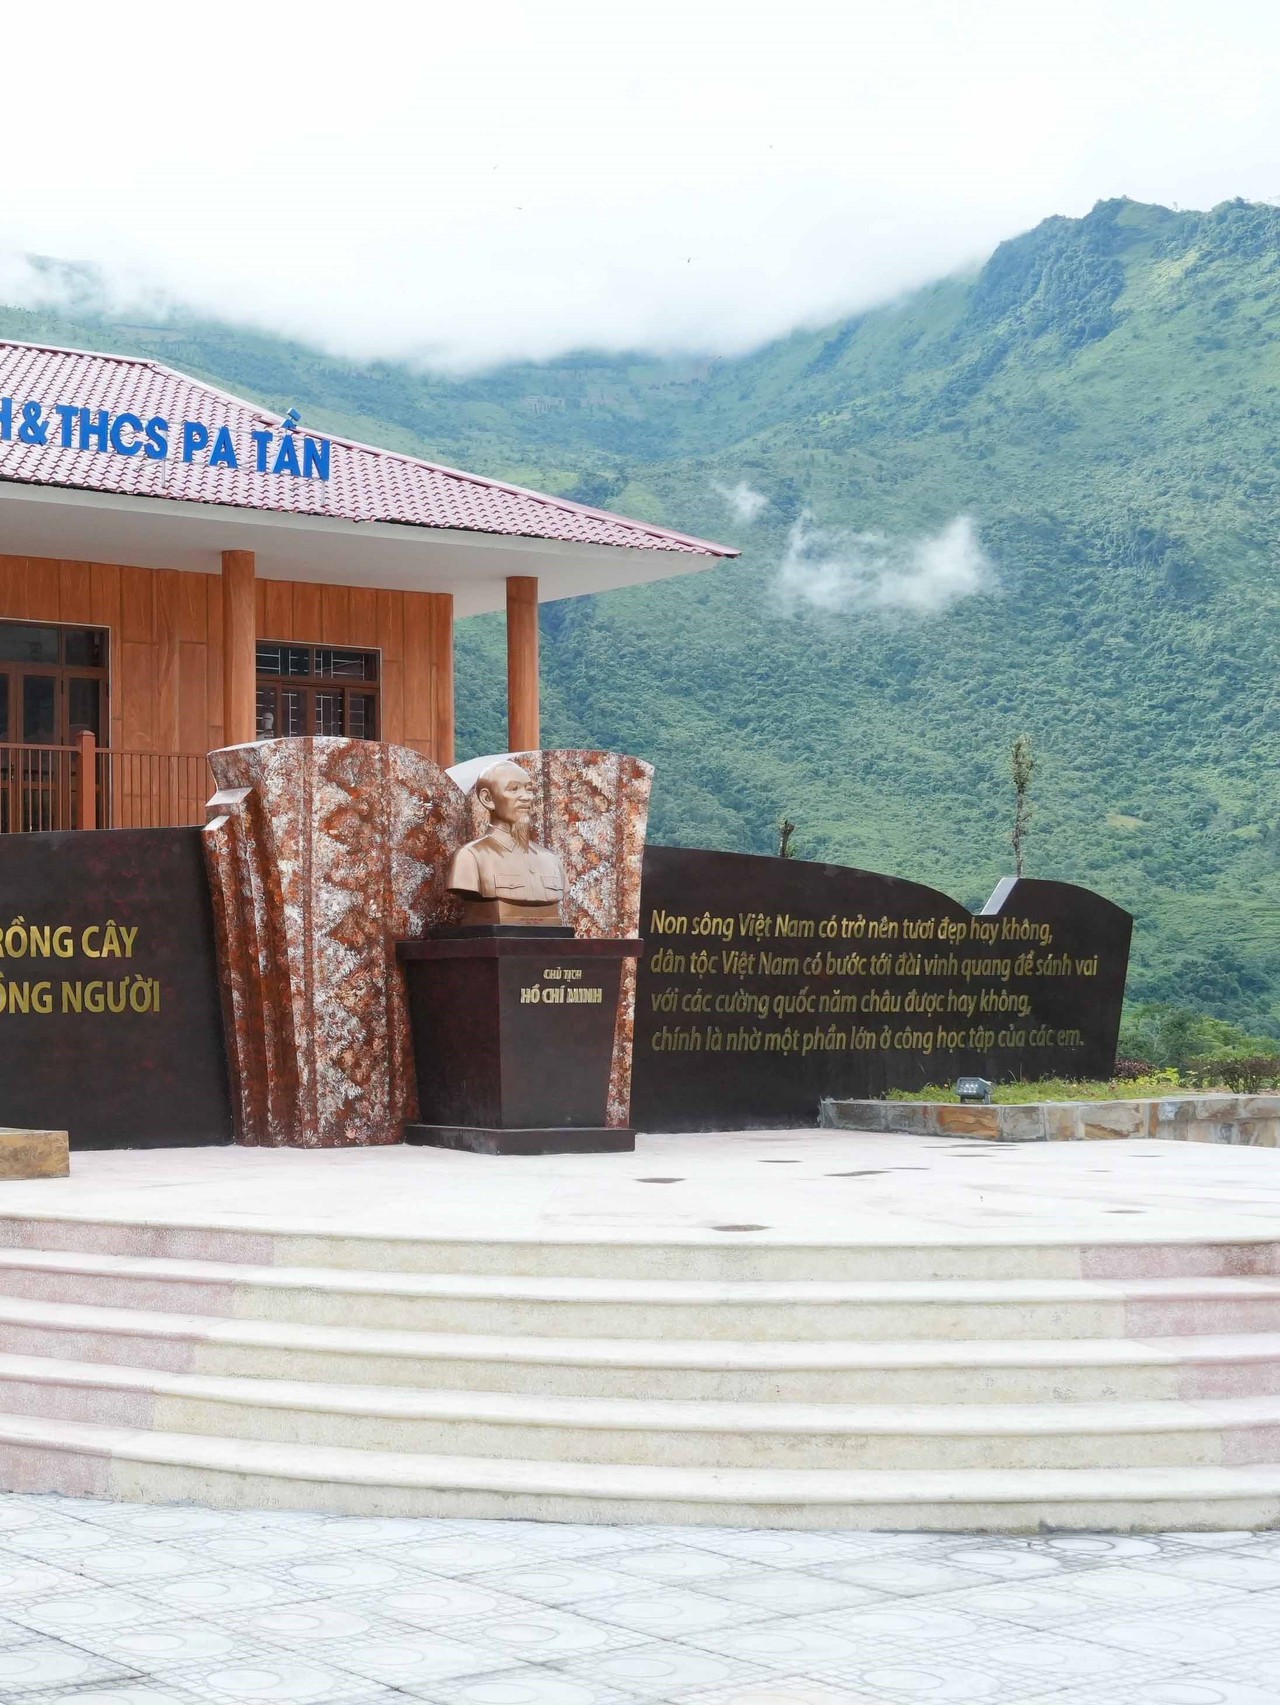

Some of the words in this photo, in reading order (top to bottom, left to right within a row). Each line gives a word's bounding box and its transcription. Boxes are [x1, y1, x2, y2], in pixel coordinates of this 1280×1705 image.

[183, 421, 237, 469] PA
[251, 407, 330, 481] TẦN
[81, 919, 138, 958] CÂY
[650, 909, 687, 934] Non
[691, 911, 734, 942] sông
[738, 912, 771, 942] Việt
[775, 913, 815, 938] Nam
[818, 914, 838, 938] có
[841, 914, 866, 938] trở
[868, 915, 899, 939] nên
[902, 917, 935, 940] tươi
[937, 916, 968, 945] đẹp
[970, 918, 1000, 946] hay
[1001, 917, 1054, 947] không,
[650, 948, 686, 974] dân
[690, 950, 718, 980] tộc
[722, 950, 756, 980] Việt
[758, 952, 799, 976] Nam
[802, 951, 822, 975] có
[825, 951, 867, 976] bước
[869, 952, 892, 976] tới
[894, 952, 922, 976] đài
[923, 953, 960, 977] vinh
[961, 957, 1011, 981] quang
[1013, 949, 1035, 977] để
[1035, 953, 1072, 977] sánh
[1075, 954, 1099, 977] vai
[61, 973, 161, 1014] NGƯỜI
[541, 985, 566, 1004] CHÍ
[566, 987, 603, 1004] MINH
[651, 987, 680, 1013] với
[681, 988, 712, 1013] các
[714, 988, 770, 1019] cường
[773, 985, 817, 1020] quốc
[819, 989, 857, 1013] năm
[860, 988, 902, 1013] châu
[904, 988, 946, 1018] được
[947, 988, 979, 1018] hay
[979, 988, 1033, 1018] không,
[651, 1025, 702, 1051] chính
[705, 1025, 721, 1051] là
[726, 1026, 764, 1051] nhờ
[764, 1026, 801, 1056] một
[801, 1023, 847, 1057] phần
[849, 1025, 877, 1050] lớn
[879, 1024, 893, 1050] ở
[893, 1025, 934, 1055] công
[936, 1025, 967, 1054] học
[969, 1026, 996, 1054] tập
[997, 1023, 1027, 1048] của
[1028, 1023, 1055, 1048] các
[1056, 1028, 1085, 1048] em.
